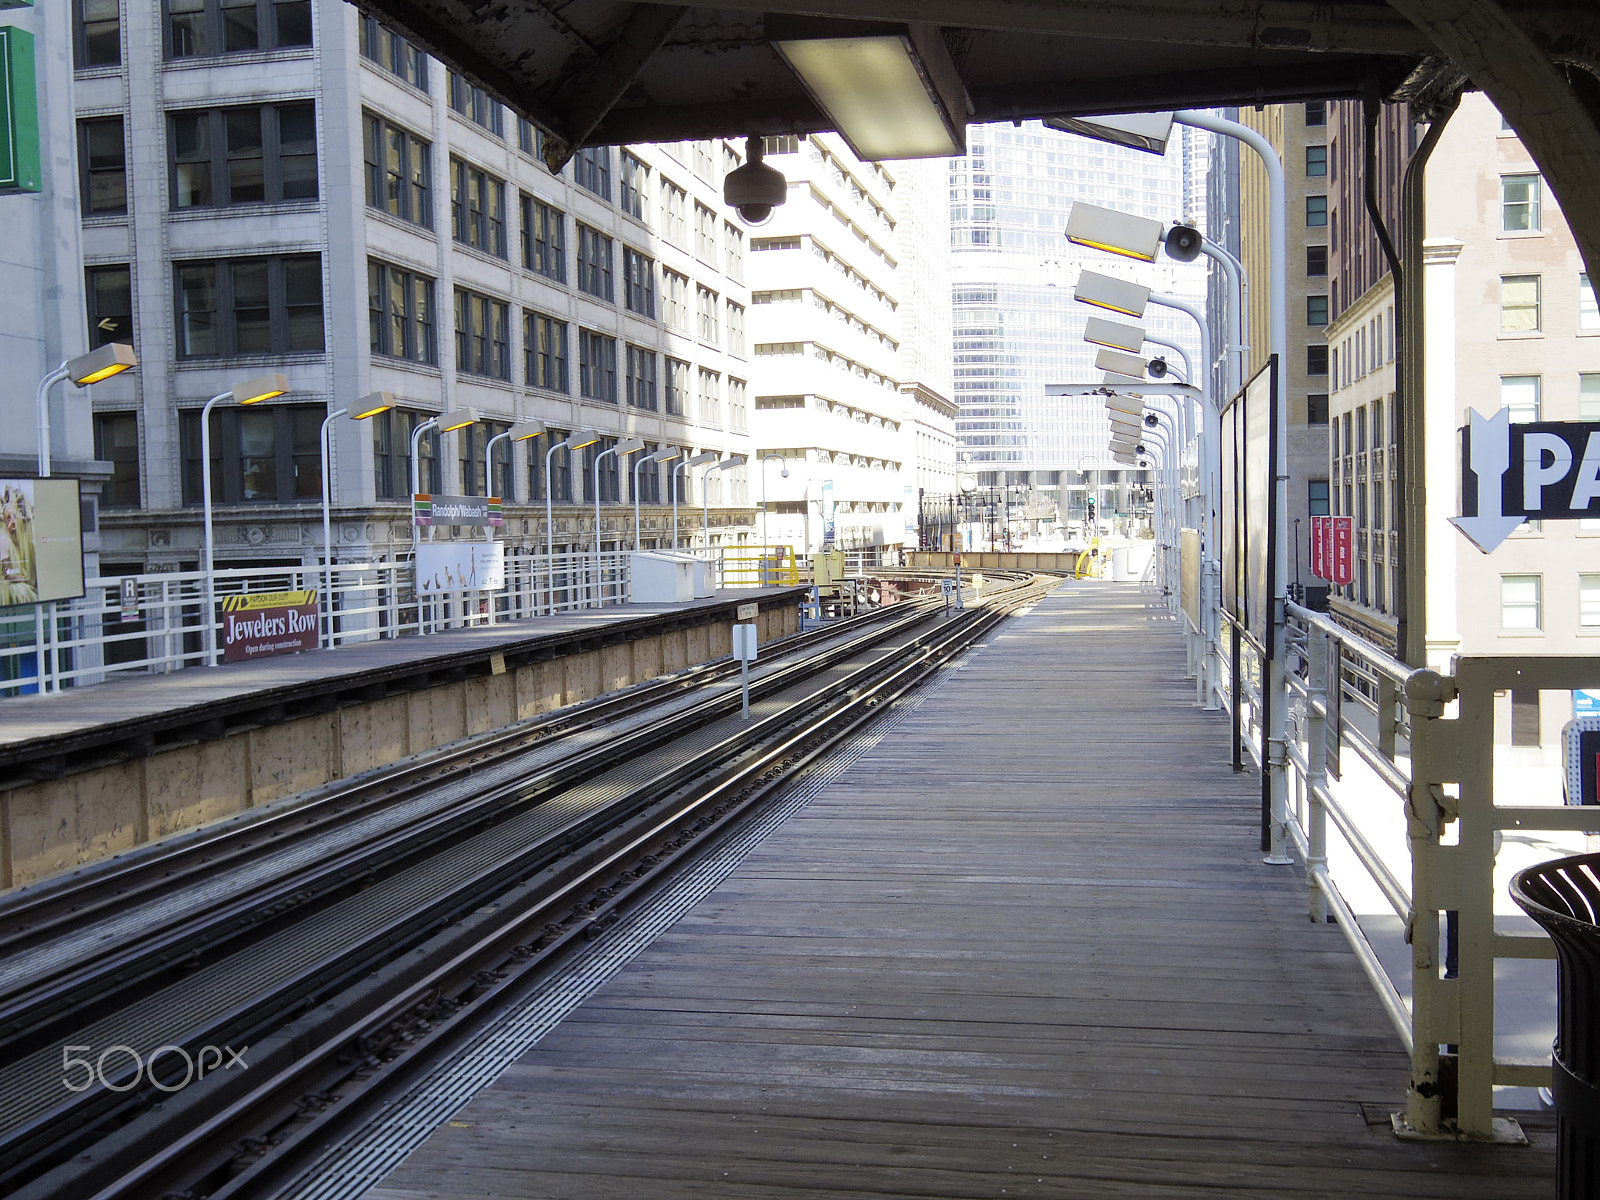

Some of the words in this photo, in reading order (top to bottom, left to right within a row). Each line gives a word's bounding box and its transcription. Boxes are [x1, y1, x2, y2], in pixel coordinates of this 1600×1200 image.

[432, 504, 482, 520] Randolph/Wabash
[125, 580, 135, 597] R
[226, 612, 286, 645] Jewelers
[287, 609, 317, 634] Row
[245, 645, 258, 655] Open
[259, 642, 274, 652] during
[275, 639, 301, 649] construction
